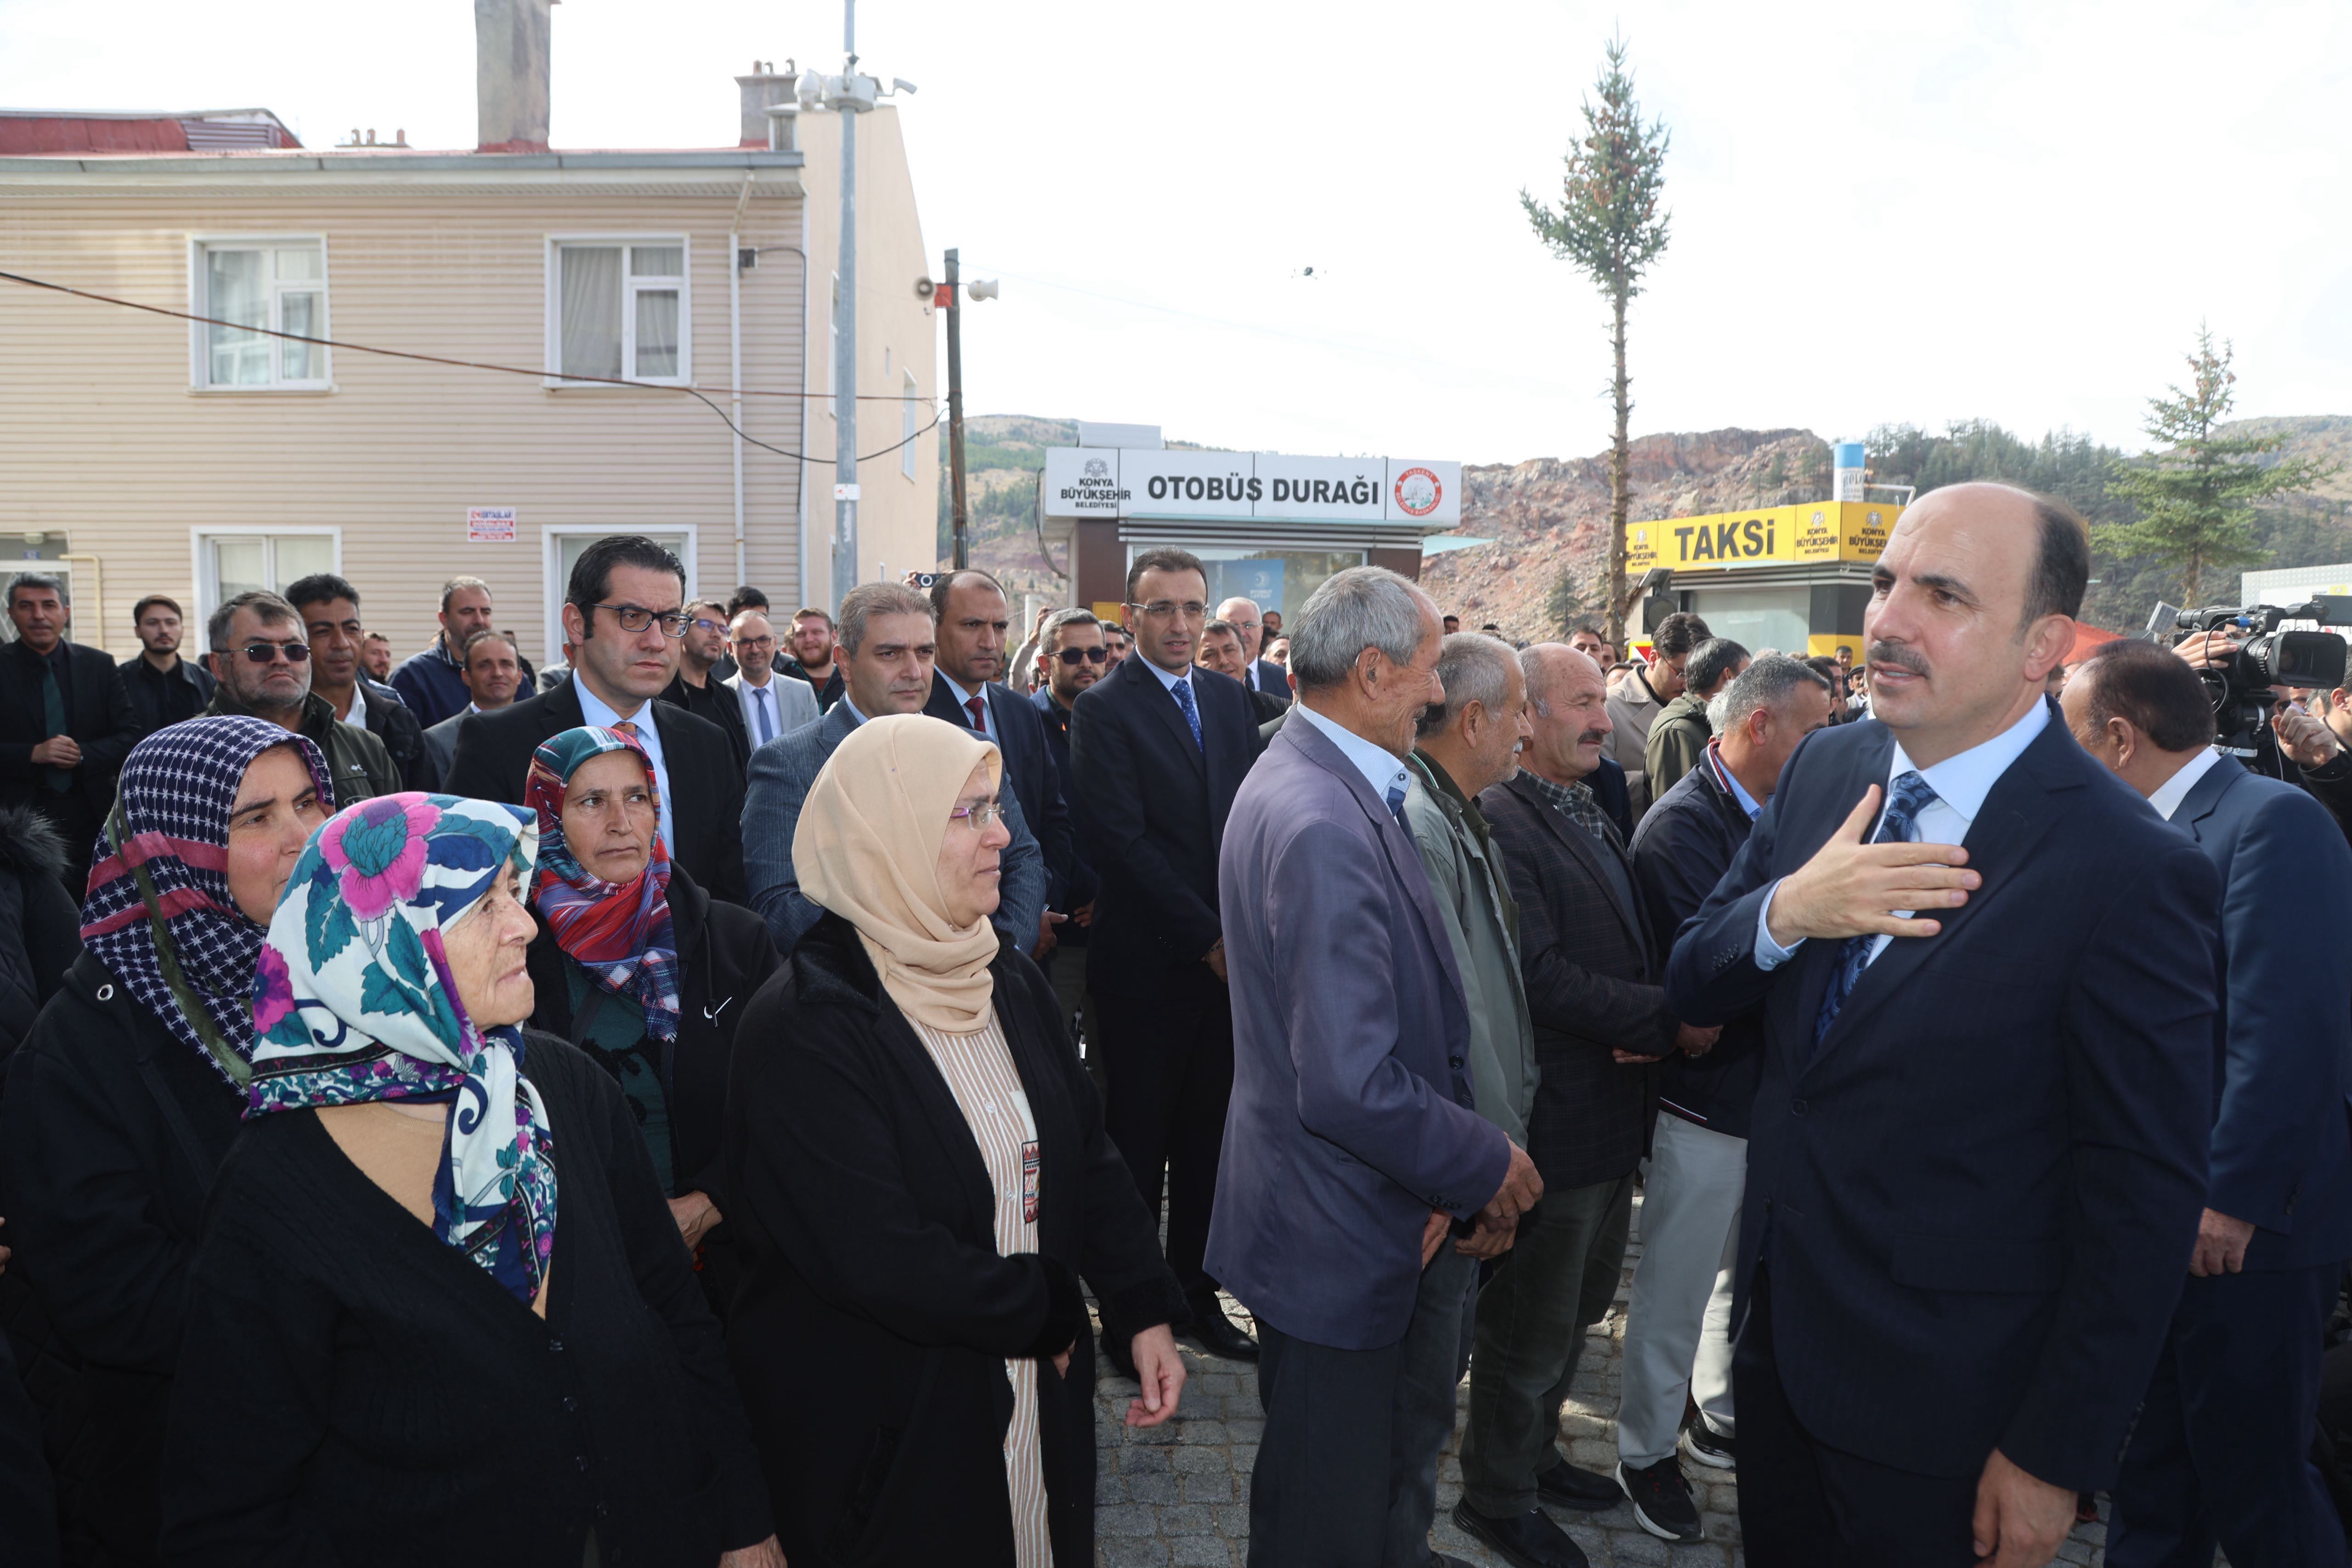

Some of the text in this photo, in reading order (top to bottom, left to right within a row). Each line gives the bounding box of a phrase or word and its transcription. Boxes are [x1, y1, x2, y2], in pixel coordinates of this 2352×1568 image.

[1079, 478, 1114, 487] KONYA
[1148, 472, 1379, 505] OTOBÜS DURAĞI
[1061, 487, 1131, 501] BÜYÜKŞEHİR
[1862, 527, 1886, 536] KONYA
[1796, 534, 1838, 547] BÜYÜKŞEHİR
[1849, 534, 1887, 548] BÜYÜKŞE
